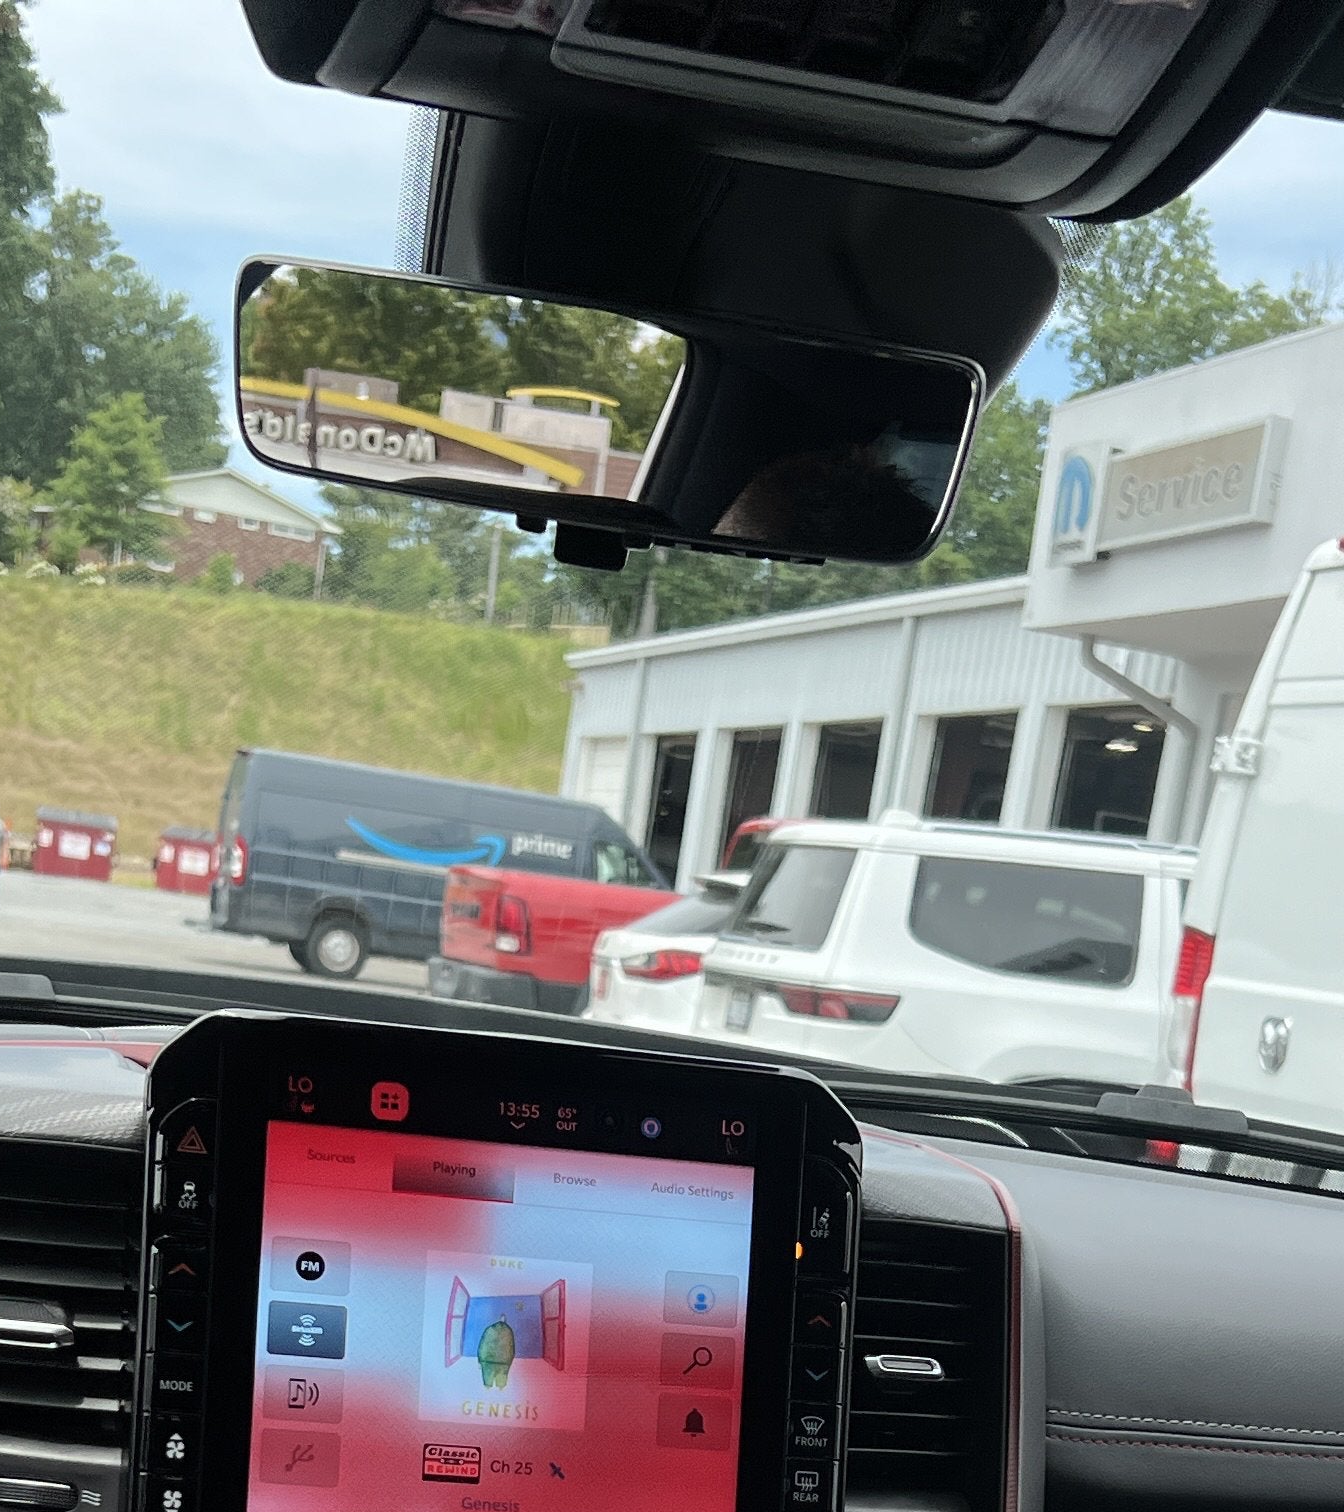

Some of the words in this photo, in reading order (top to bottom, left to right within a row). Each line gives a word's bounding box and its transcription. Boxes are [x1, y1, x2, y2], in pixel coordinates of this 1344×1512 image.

[1115, 463, 1244, 522] Service
[511, 832, 573, 861] prime
[288, 1076, 314, 1093] LO
[499, 1101, 541, 1119] 13:55
[557, 1120, 578, 1133] OUT
[721, 1120, 746, 1137] LO
[307, 1148, 357, 1164] Sources
[432, 1161, 477, 1179] Playing
[552, 1173, 598, 1188] Browse
[651, 1182, 685, 1197] Audio
[687, 1185, 735, 1201] Settings
[810, 1229, 830, 1239] OFF
[300, 1260, 320, 1272] FM
[159, 1379, 194, 1392] MODE
[794, 1435, 828, 1448] FRONT
[427, 1446, 479, 1460] Classic
[426, 1463, 478, 1477] REWIND
[489, 1460, 511, 1475] Ch
[514, 1461, 534, 1476] 25
[792, 1491, 819, 1503] REAR
